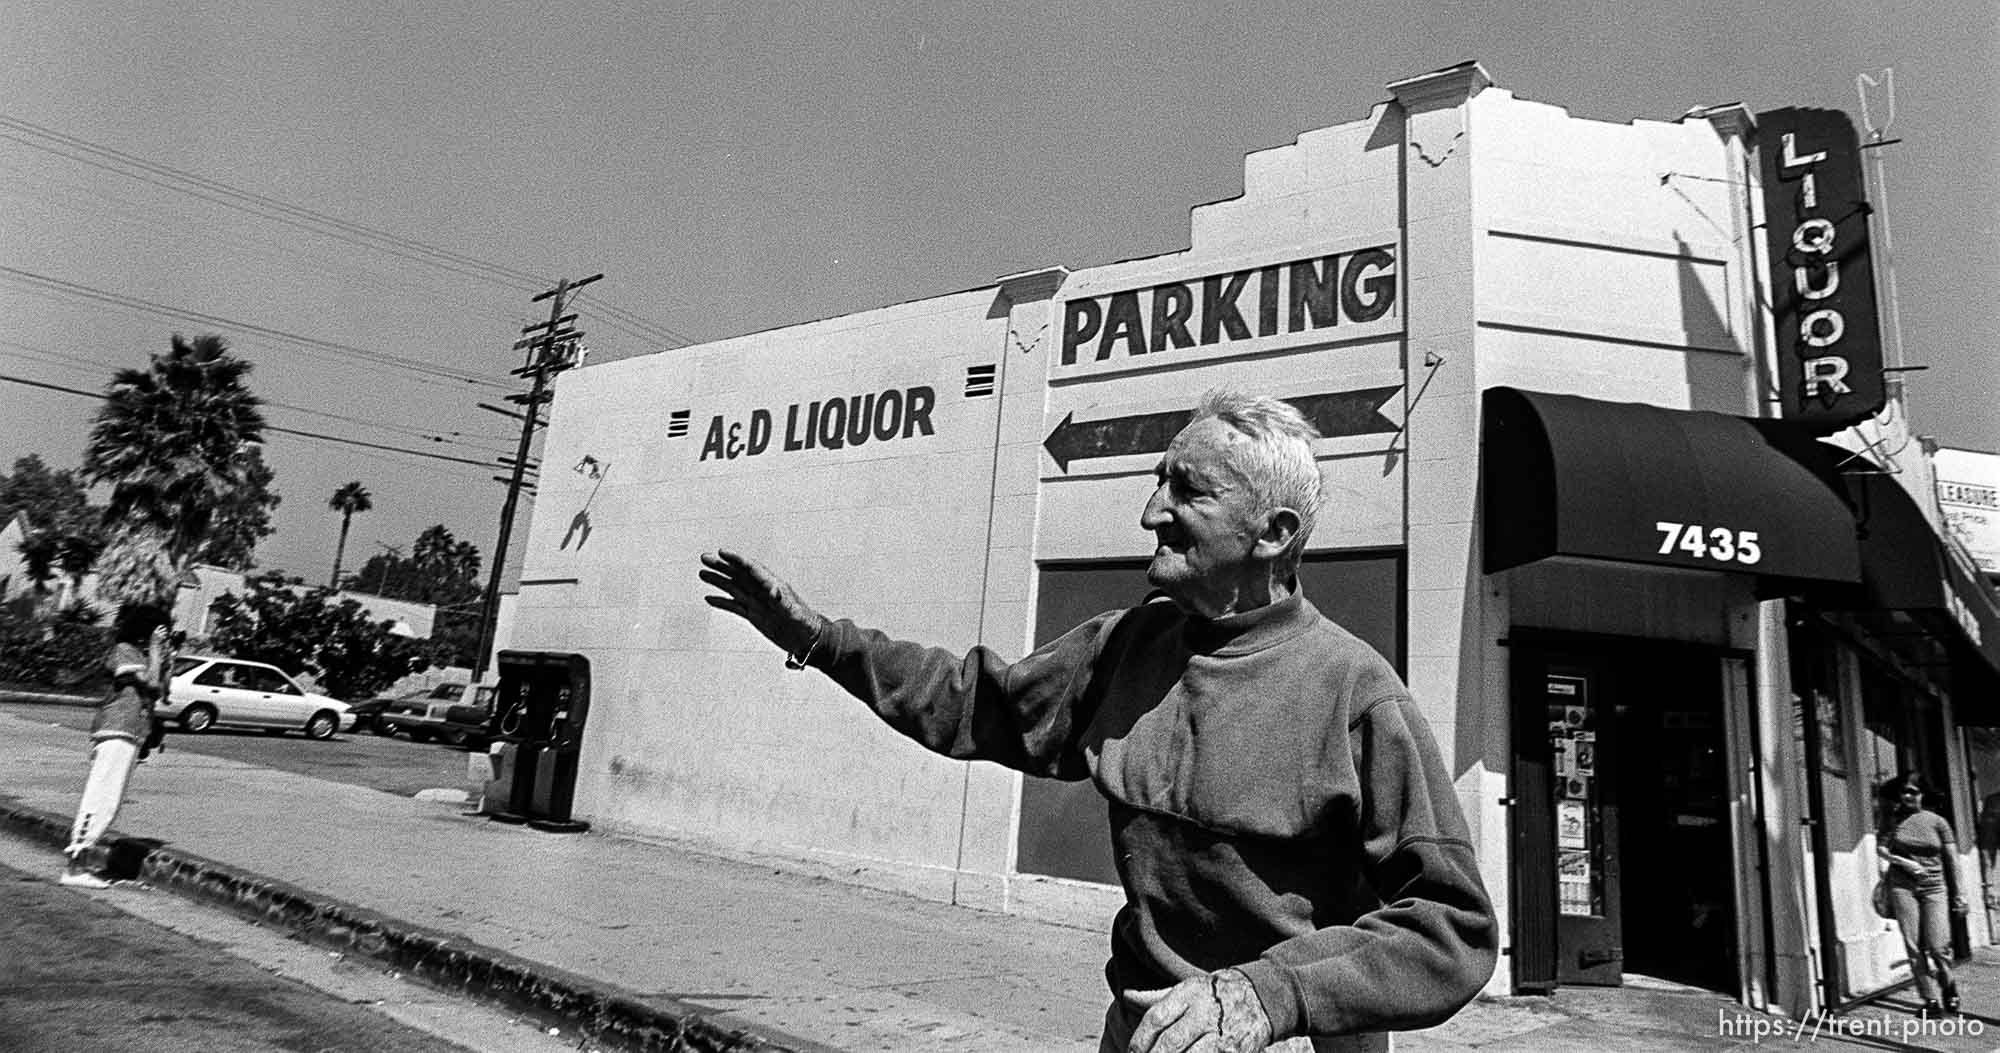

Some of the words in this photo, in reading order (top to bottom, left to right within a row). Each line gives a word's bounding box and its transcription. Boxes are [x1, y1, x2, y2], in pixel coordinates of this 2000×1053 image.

[1061, 246, 1397, 366] PARKING
[1782, 133, 1850, 397] LIQUOR
[699, 409, 772, 462] A&D
[783, 385, 936, 452] LIQUOR
[1656, 521, 1761, 565] 7435
